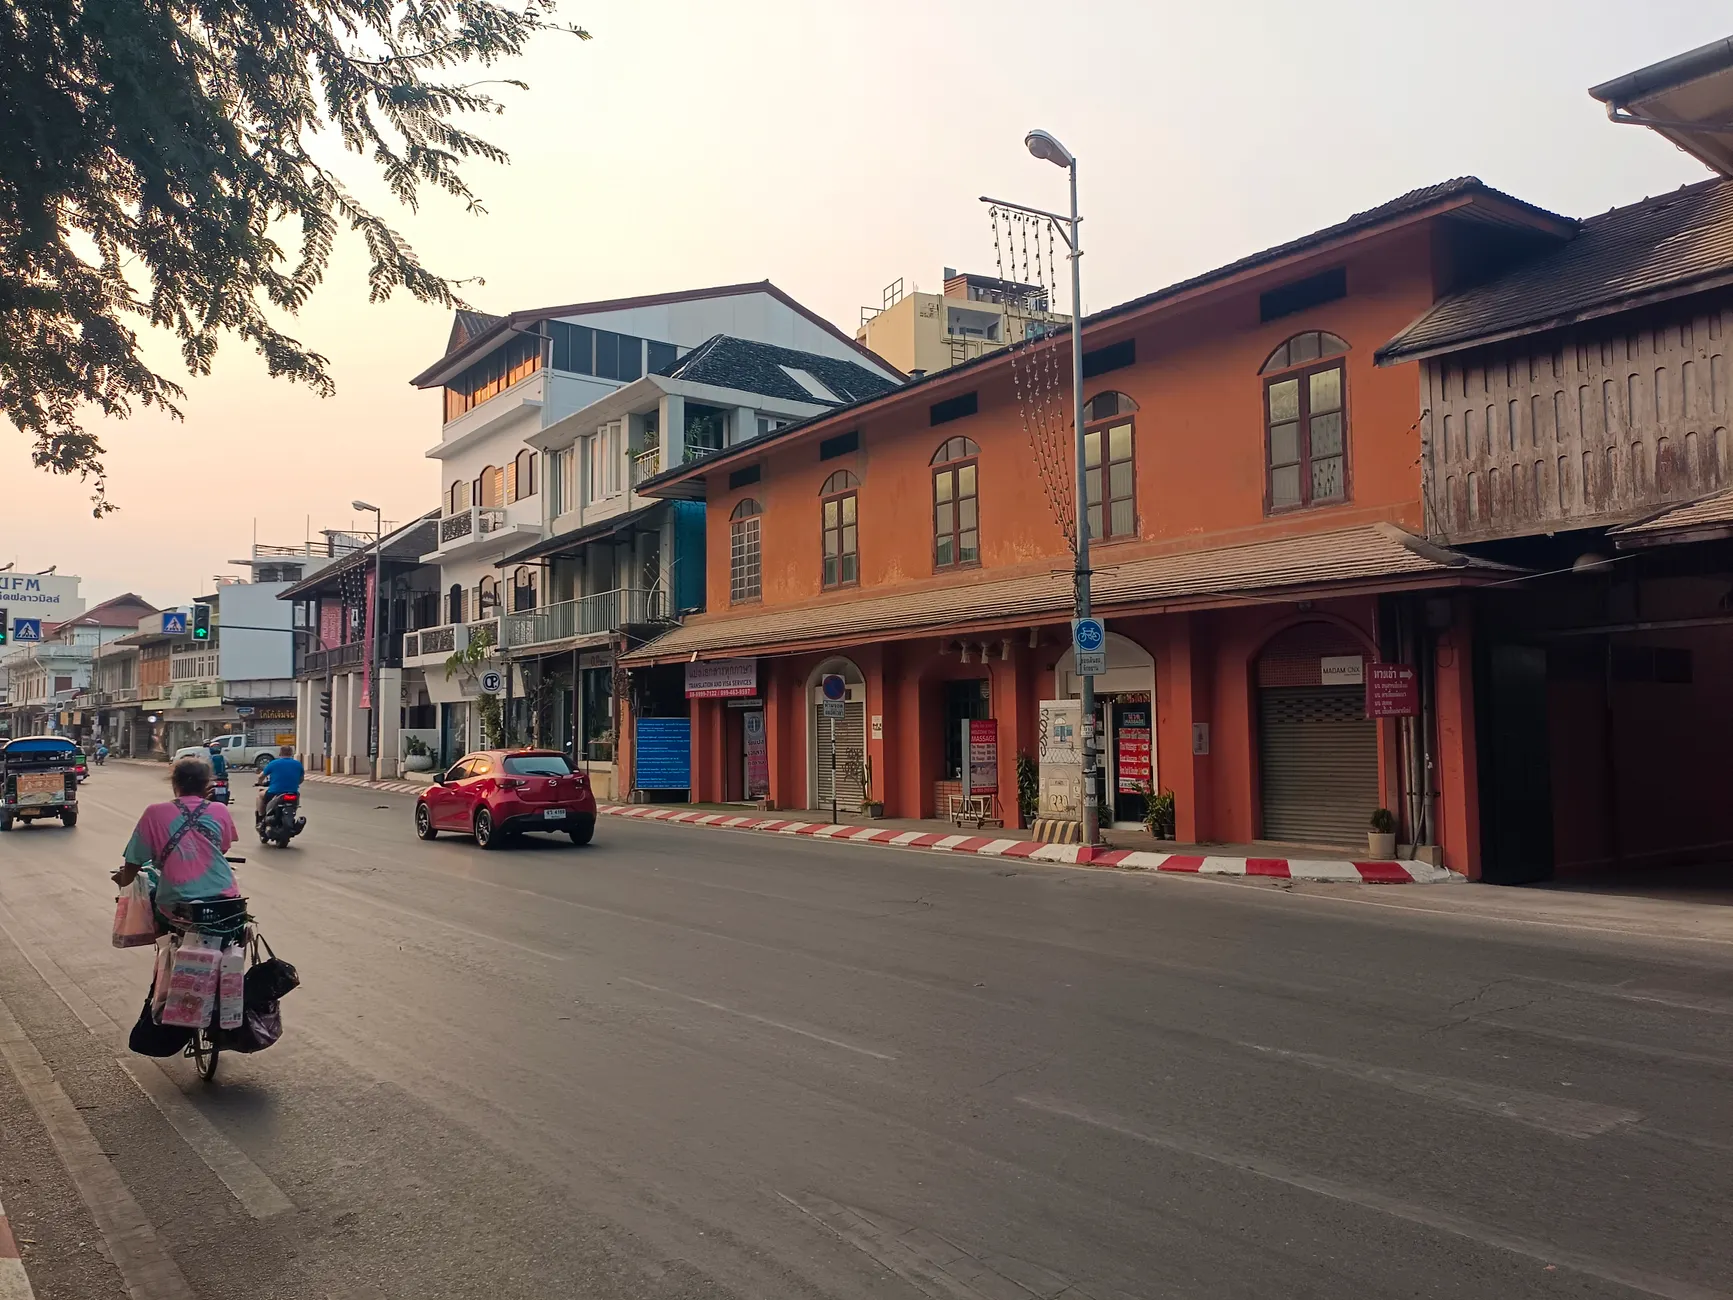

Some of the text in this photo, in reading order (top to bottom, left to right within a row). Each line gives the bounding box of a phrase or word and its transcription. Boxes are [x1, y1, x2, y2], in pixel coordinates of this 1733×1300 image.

[0, 592, 60, 603] ดฟลาวมิลล์
[1374, 666, 1396, 679] ทางเข้า
